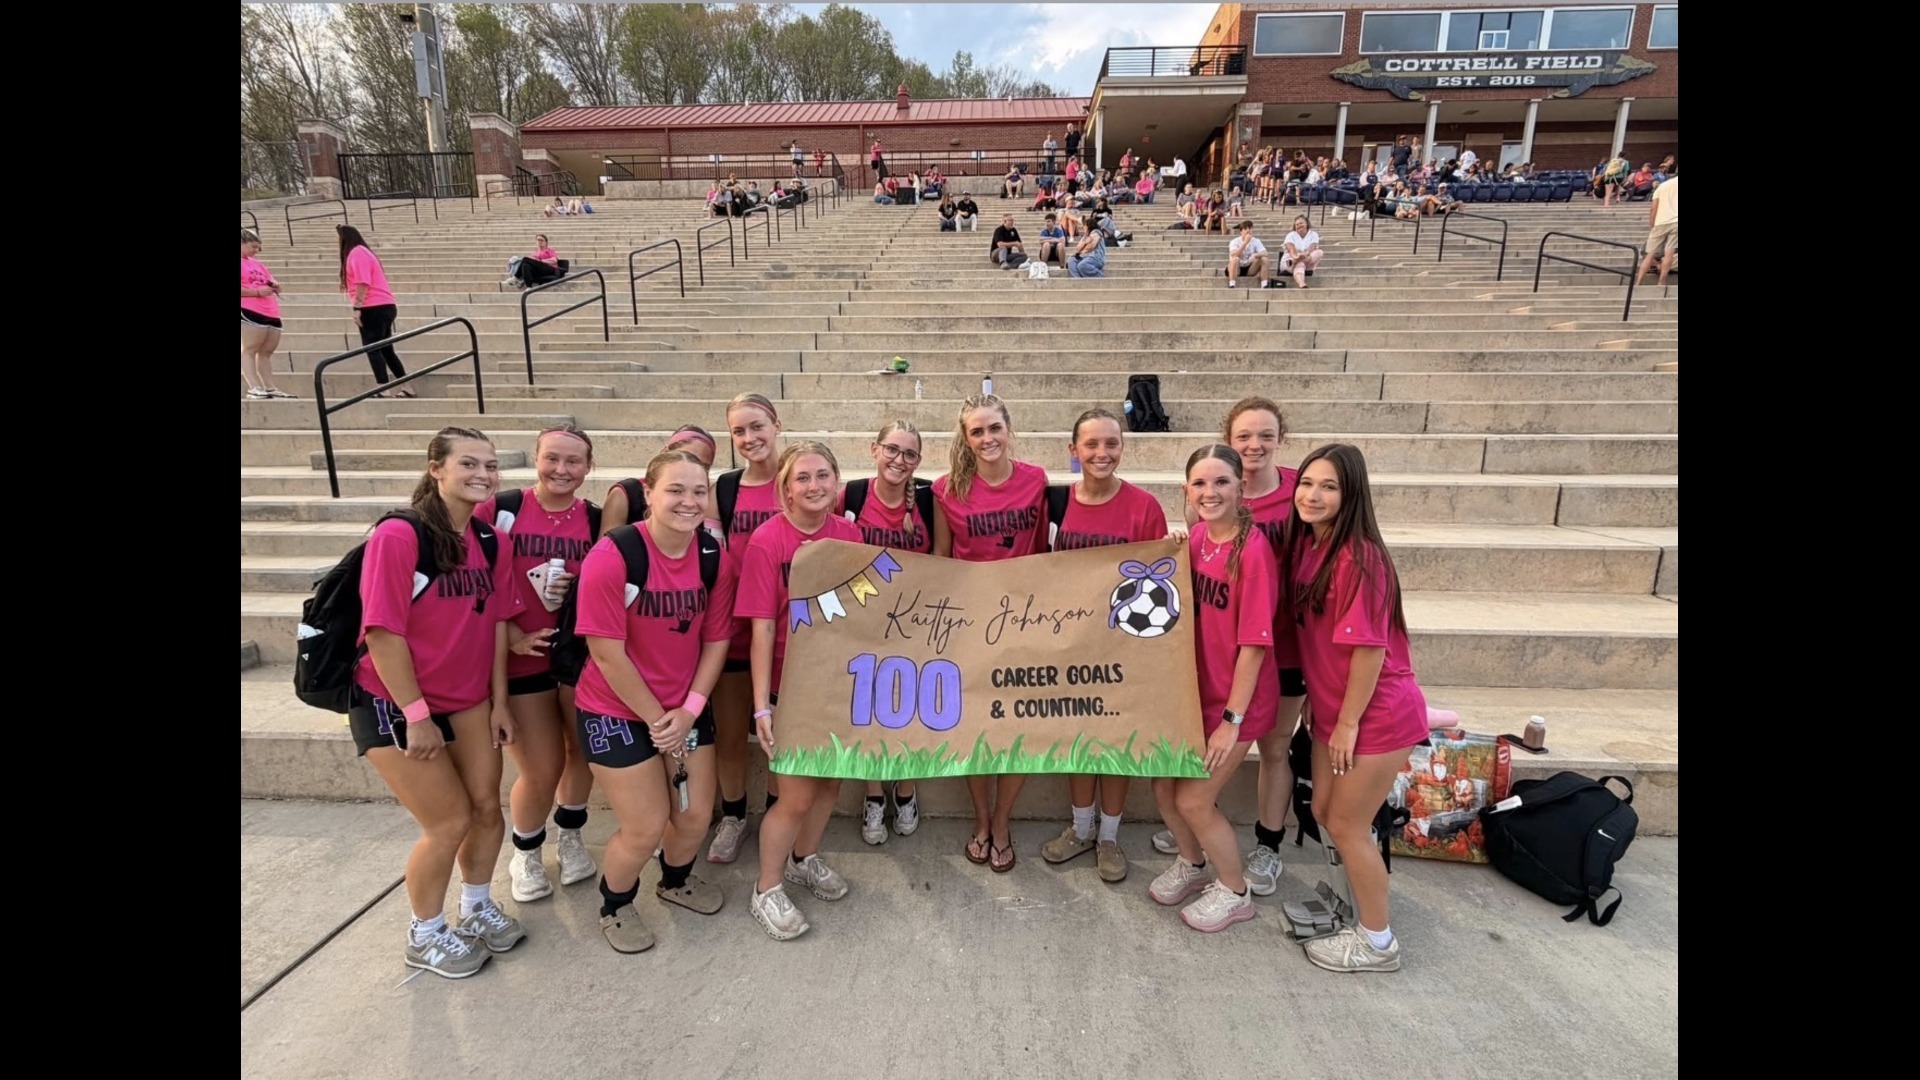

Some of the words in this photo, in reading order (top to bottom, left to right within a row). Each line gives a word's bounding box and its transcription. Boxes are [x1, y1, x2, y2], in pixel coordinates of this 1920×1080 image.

[1385, 57, 1518, 72] COTTRELL
[1525, 56, 1603, 70] FIELD
[1436, 76, 1481, 87] EST.
[1489, 75, 1535, 86] 2016
[966, 505, 1038, 538] INDIANS
[885, 590, 974, 654] Kaitlyn
[986, 594, 1094, 645] Johnson
[991, 665, 1059, 688] CAREER
[1066, 663, 1123, 685] GOALS
[847, 653, 962, 731] 100
[990, 699, 1005, 719] &
[1013, 696, 1120, 718] COUNTING...
[585, 714, 634, 754] 24
